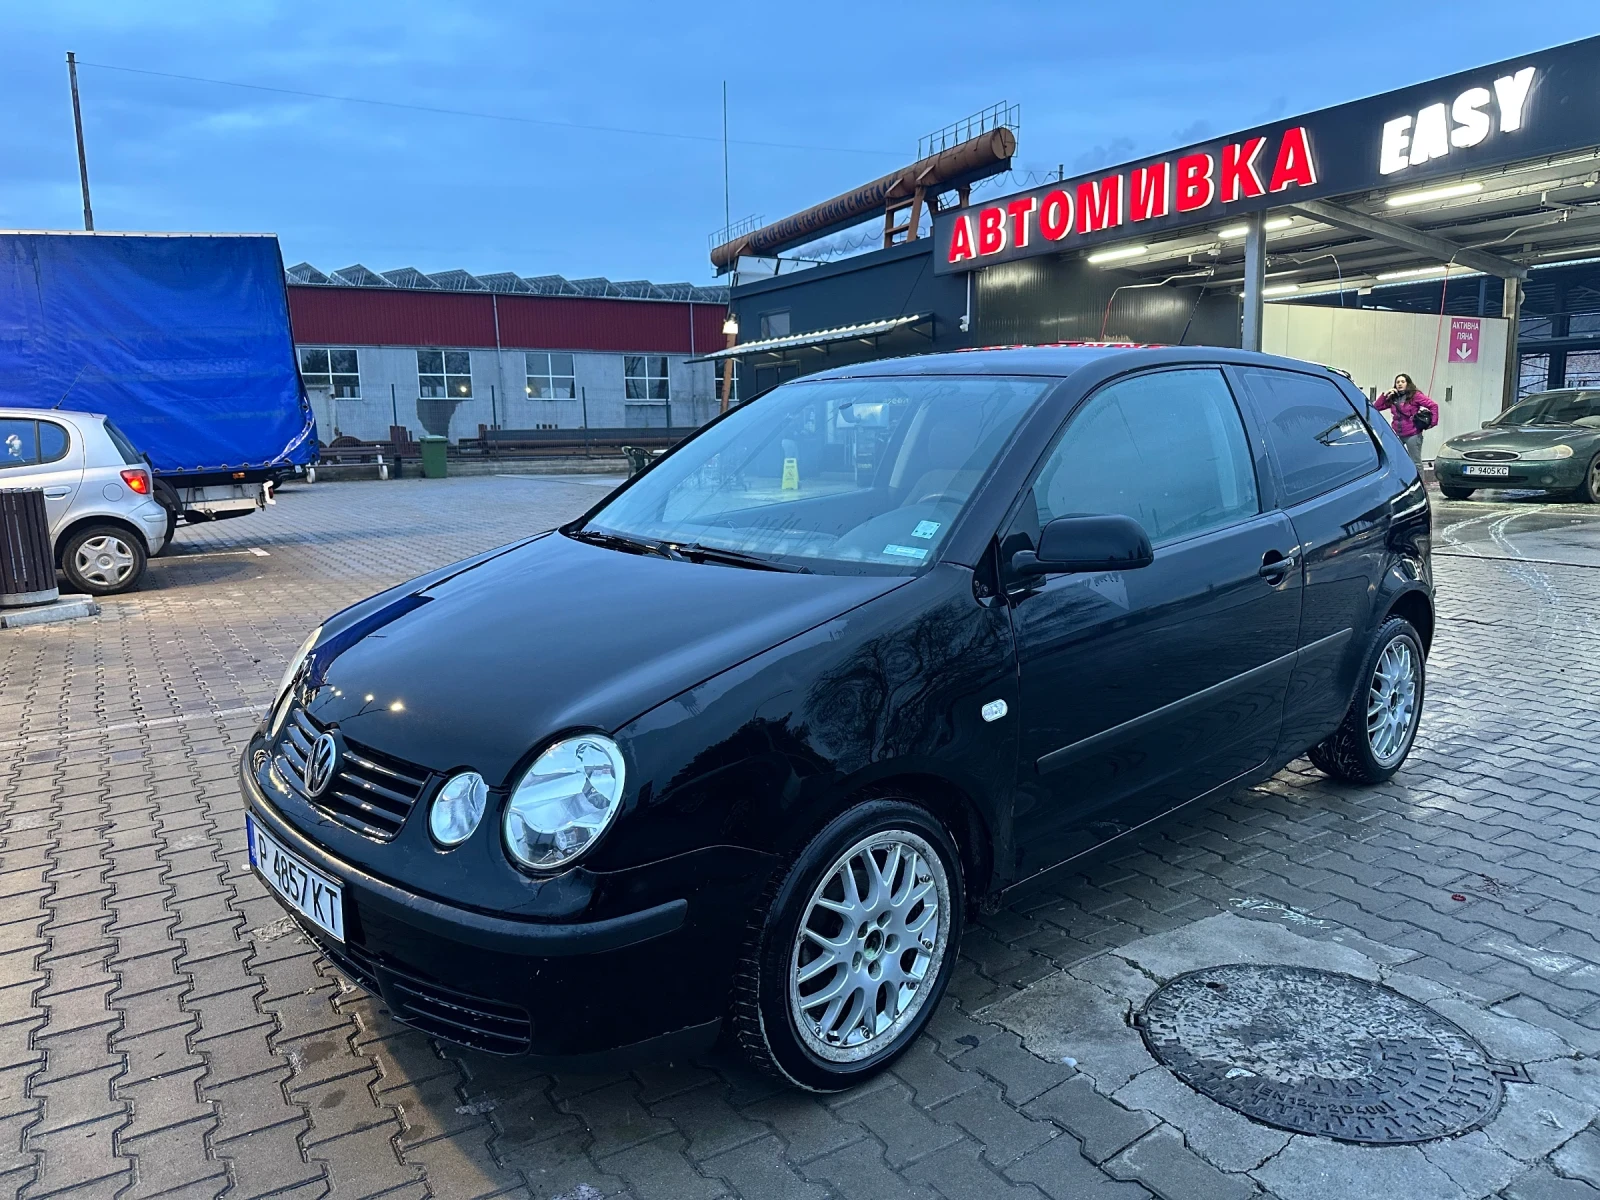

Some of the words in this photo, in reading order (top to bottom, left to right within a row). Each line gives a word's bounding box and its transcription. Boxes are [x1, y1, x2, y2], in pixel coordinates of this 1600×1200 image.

[1379, 67, 1536, 175] EASY
[948, 127, 1318, 263] АВТОМИВКА
[1452, 321, 1479, 330] АКТИВНА
[1456, 332, 1473, 340] ПЯНА
[258, 832, 267, 870] P
